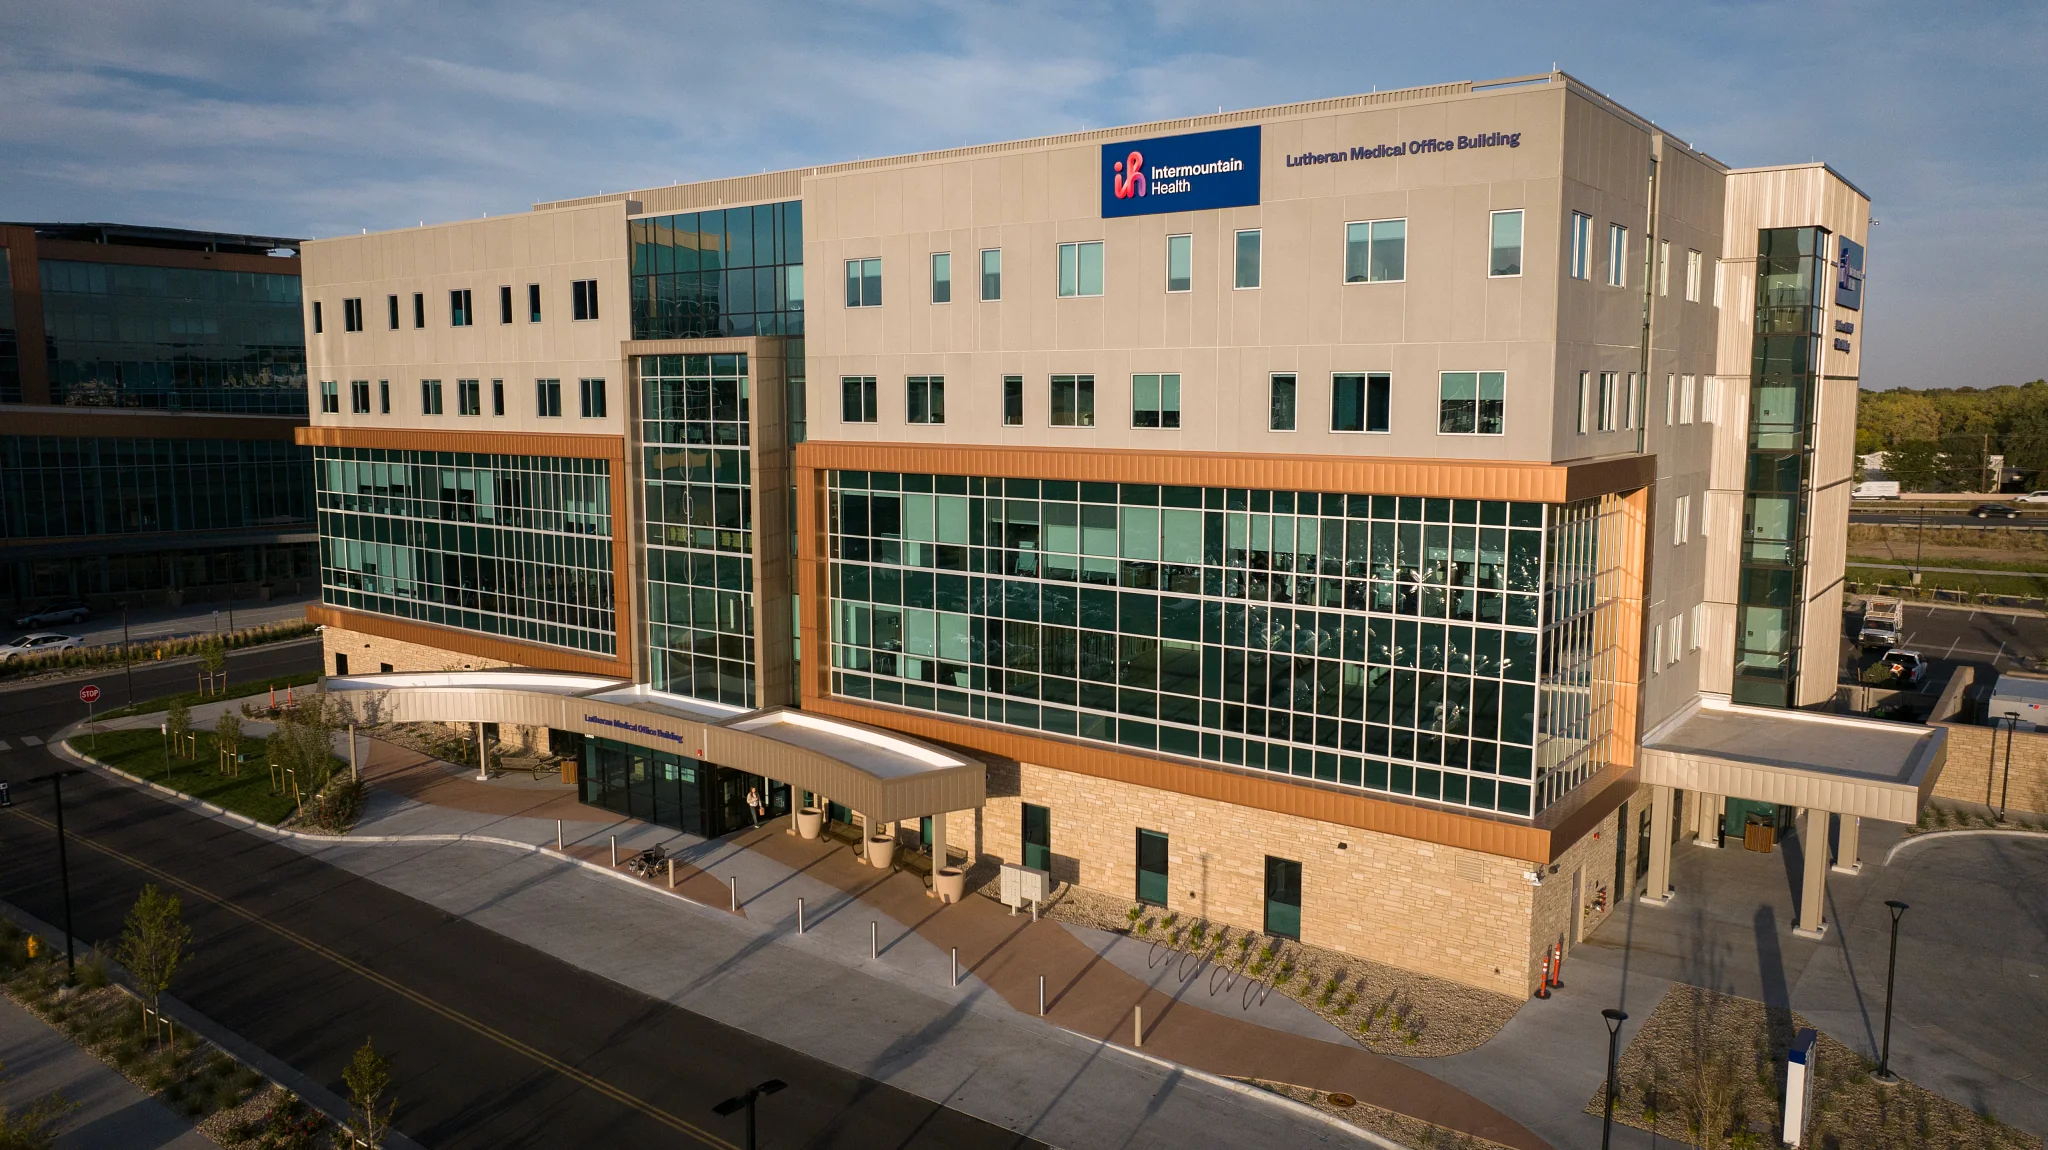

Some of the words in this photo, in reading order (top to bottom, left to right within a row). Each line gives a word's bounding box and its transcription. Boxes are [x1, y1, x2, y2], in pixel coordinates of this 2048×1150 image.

[1286, 150, 1348, 167] Lutheran
[1350, 142, 1406, 161] Medical
[1408, 138, 1454, 155] Office
[1457, 132, 1521, 150] Building
[1151, 158, 1243, 180] Intermountain
[1151, 179, 1191, 195] Health
[81, 689, 99, 698] STOP
[584, 714, 613, 726] Lutheran
[613, 719, 638, 732] Medical
[637, 725, 657, 736] Office
[657, 729, 683, 744] Building
